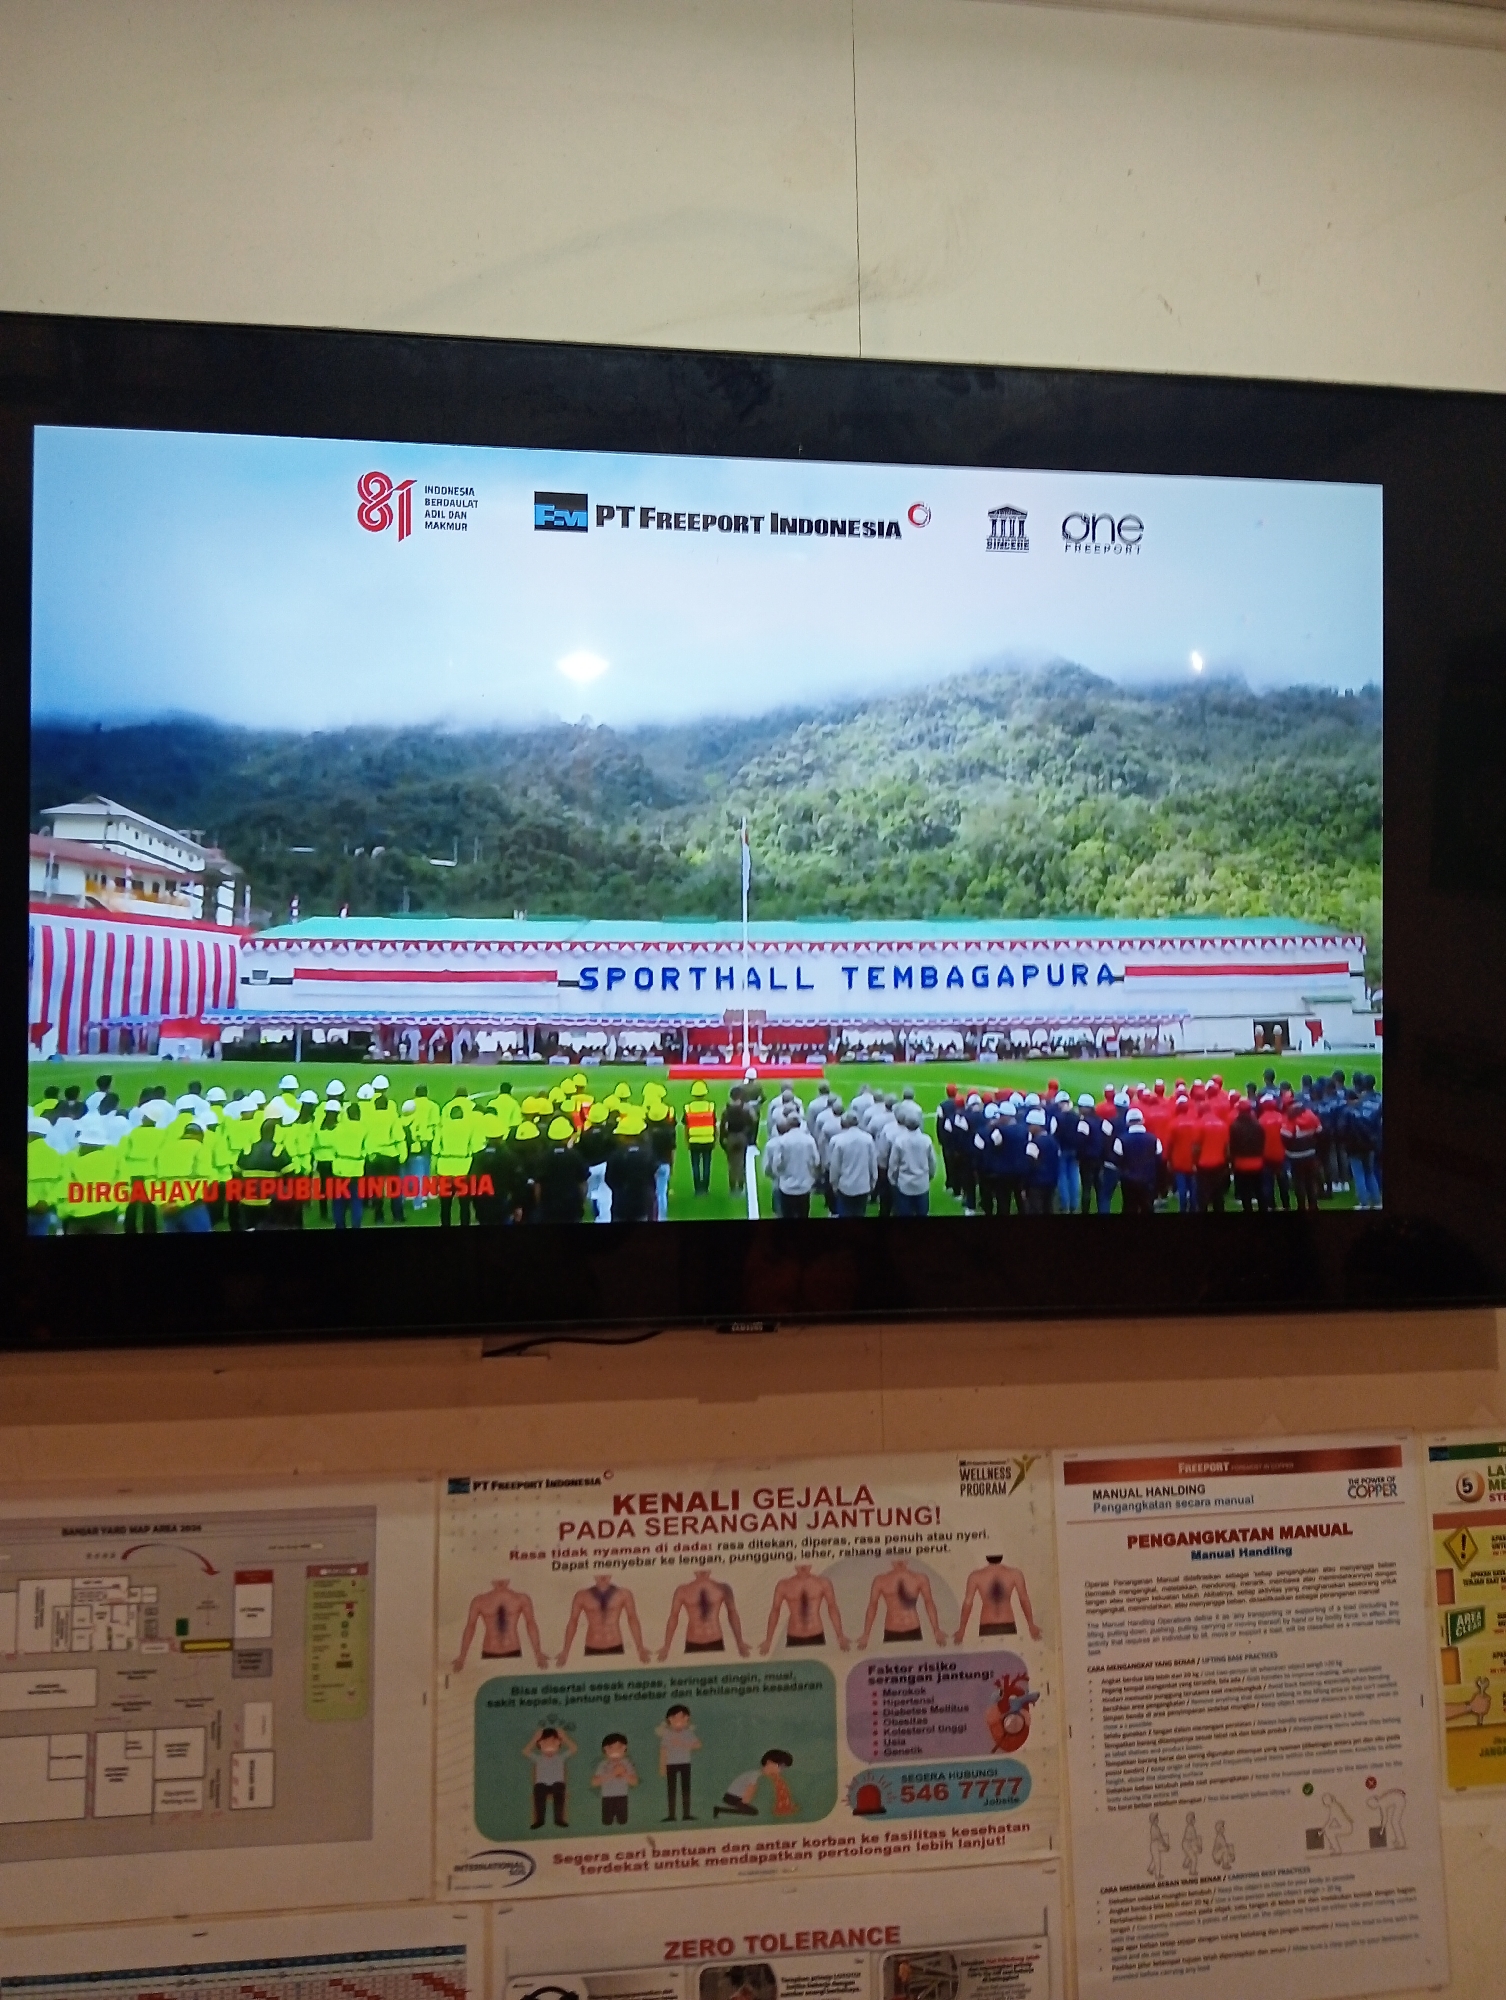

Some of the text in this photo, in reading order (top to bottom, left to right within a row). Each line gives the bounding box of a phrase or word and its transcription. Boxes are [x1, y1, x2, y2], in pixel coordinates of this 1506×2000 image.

[425, 485, 475, 496] INDONESIA
[425, 498, 479, 509] BERDAULAT
[425, 509, 467, 520] ADIL DAN
[596, 504, 902, 540] PT FREEPORT INDONESIA
[425, 521, 468, 532] MAKMUR
[986, 539, 1029, 551] SINCERE
[1065, 543, 1142, 555] FREEPORT
[578, 964, 1116, 992] SPORTHALL TEMBAGAPURA
[67, 1174, 495, 1204] DIRGAHAYU REPUBLIK INDONESIA
[960, 1466, 1012, 1481] WELLNESS
[1178, 1461, 1230, 1474] FREEPORT
[1488, 1465, 1506, 1478] LA
[473, 1478, 602, 1492] PT FREEPORT INDONESIA
[961, 1482, 1007, 1497] PROGRAM
[1092, 1484, 1206, 1500] MANUAL HANLDING
[1347, 1482, 1398, 1499] COPPER
[1462, 1477, 1474, 1495] 5
[613, 1484, 875, 1516] KENALI GEJALA
[1093, 1494, 1255, 1513] Pengangkatan secara manual
[559, 1506, 941, 1541] PADA SERANGAN JANTUNG!
[1127, 1522, 1354, 1549] PENGANGKATAN MANUAL
[510, 1550, 547, 1560] Rasa
[552, 1547, 588, 1558] tidak
[594, 1545, 650, 1558] nyaman
[655, 1543, 668, 1553] di
[717, 1541, 745, 1551] rasa
[748, 1538, 798, 1550] ditekan,
[801, 1536, 851, 1548] diperas,
[855, 1535, 881, 1545] rasa
[885, 1532, 923, 1545] penuh
[927, 1532, 953, 1542] atau
[956, 1529, 990, 1543] nyeri.
[552, 1543, 951, 1572] Dapat menyebar ke lengan, punggung, leher, rahang atau perut.
[1190, 1545, 1293, 1561] Manual Handling
[868, 1662, 957, 1676] Faktor risiko
[868, 1674, 933, 1686] serangan
[901, 1768, 998, 1783] SEGERA HUBUNGI
[901, 1777, 1023, 1804] 546 7777
[553, 1822, 1031, 1866] Segera cari bantuan dan antar korban ke fasilitas kesehatan
[580, 1835, 1006, 1876] terdekat untuk mendapatkan pertolongan lebih lanjut!
[664, 1924, 902, 1961] ZERO TOLERANCE
